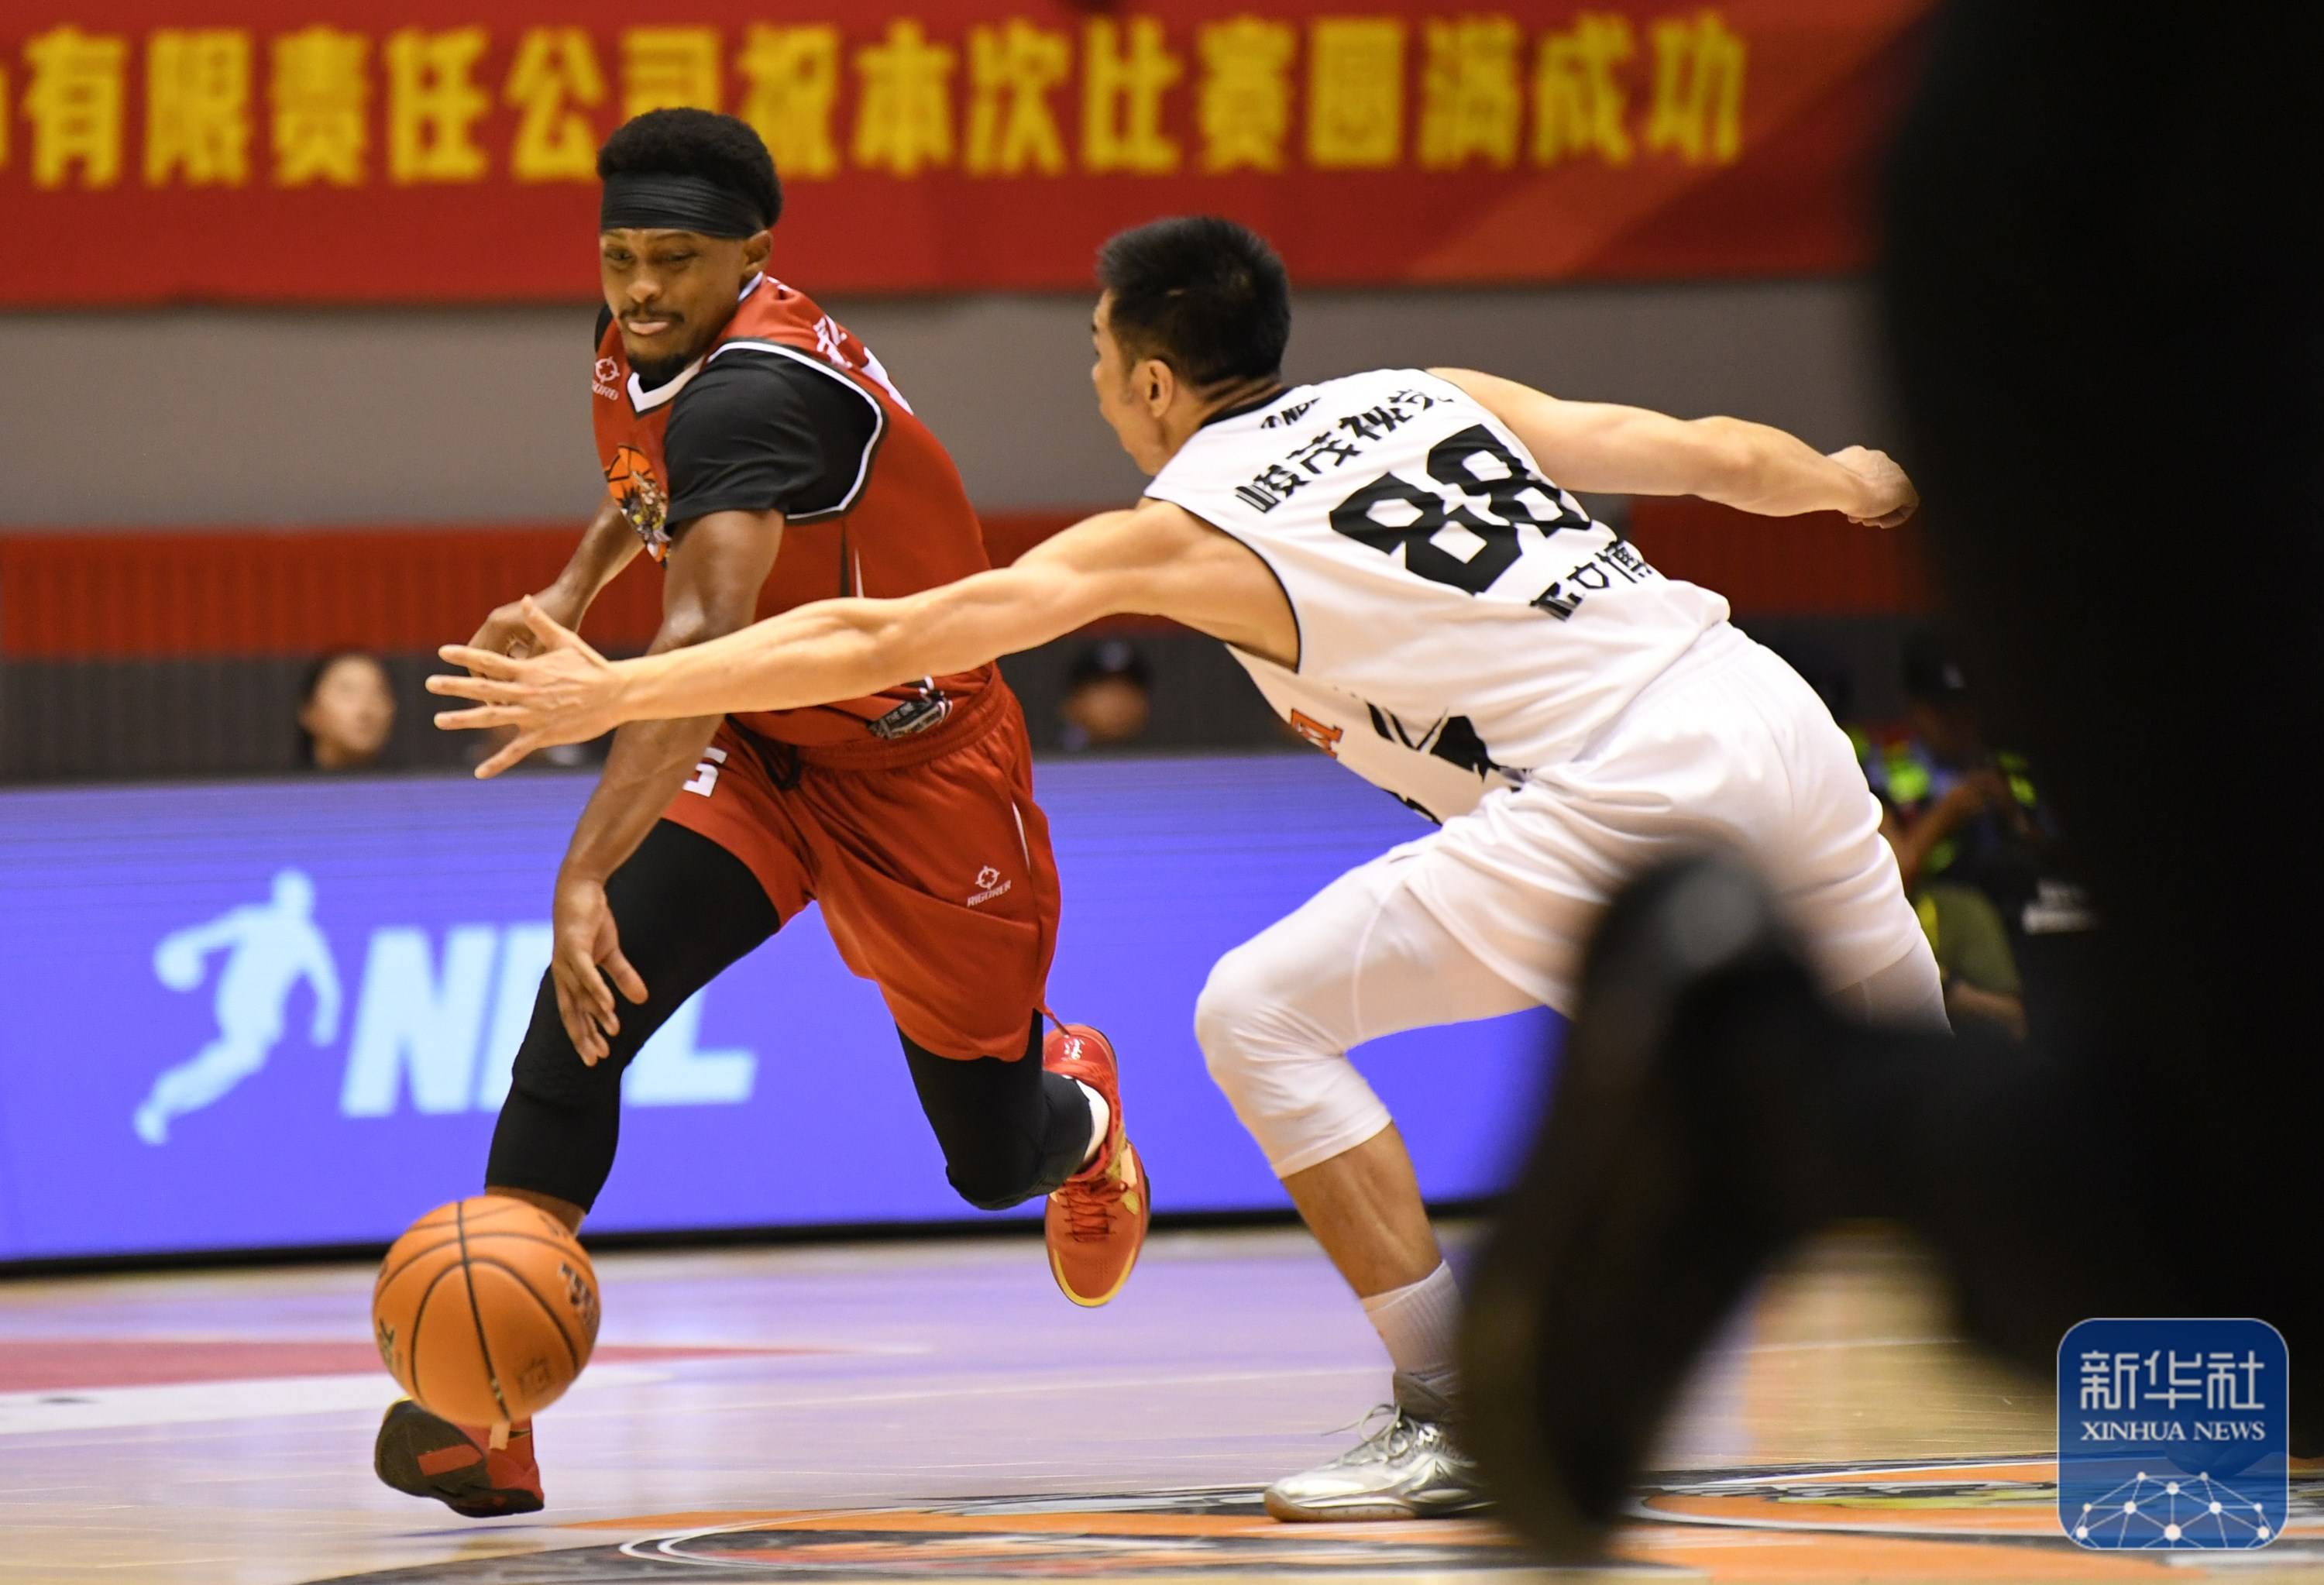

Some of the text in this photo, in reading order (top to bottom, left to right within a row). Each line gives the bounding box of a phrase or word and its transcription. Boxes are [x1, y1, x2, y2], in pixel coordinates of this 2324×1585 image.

[0, 13, 1745, 188] 有限责任公司祝本次比赛圆满成功
[1329, 423, 1591, 597] 88
